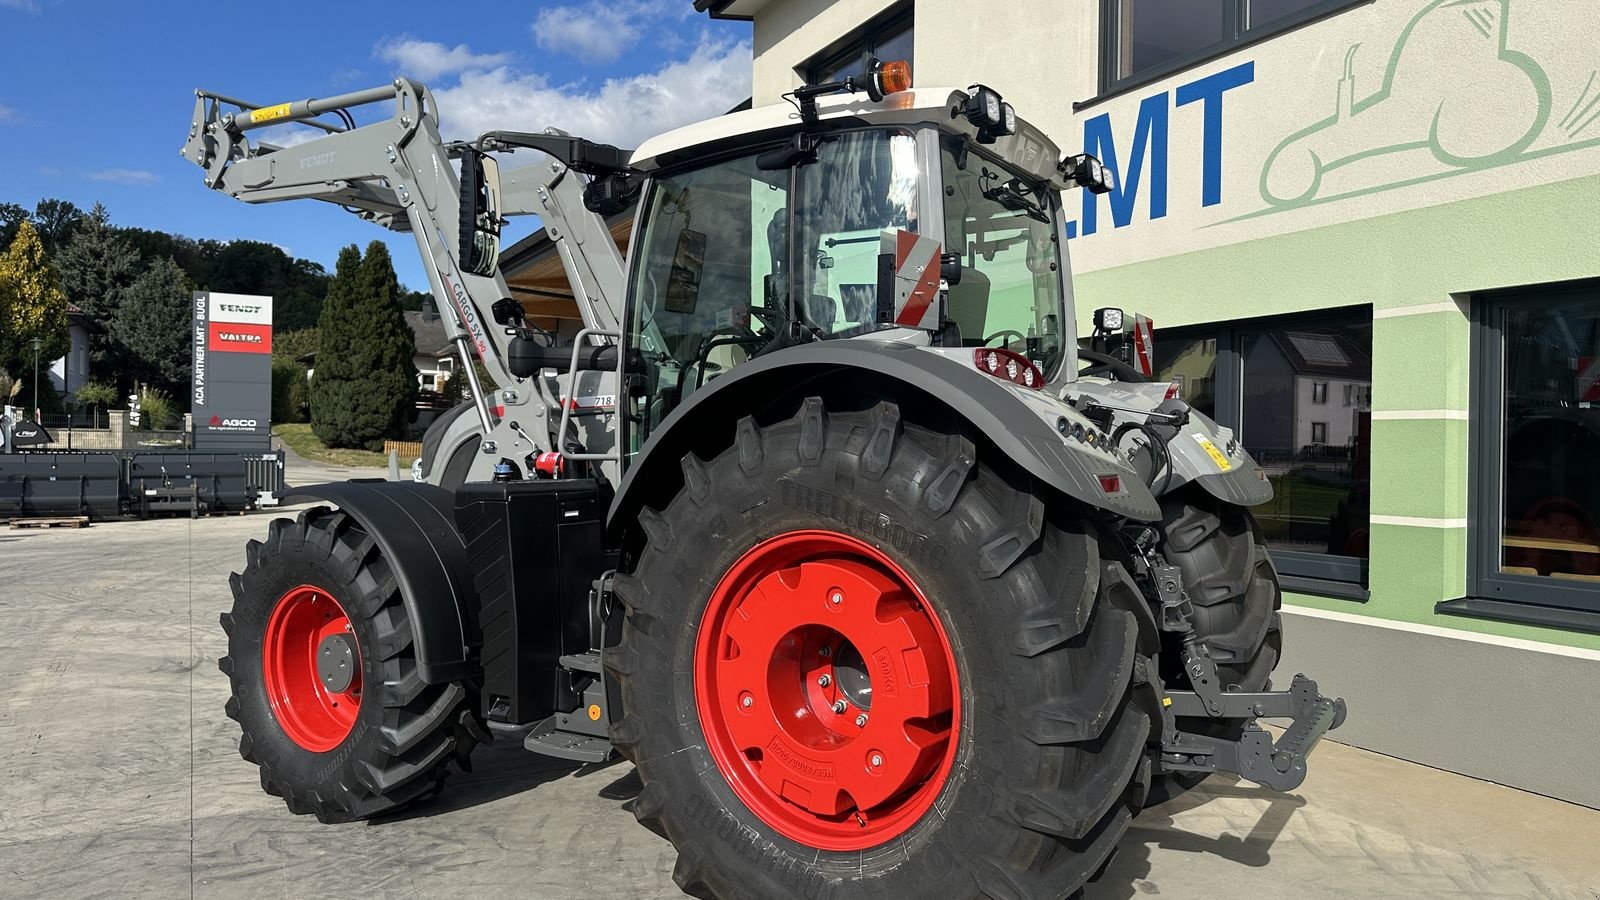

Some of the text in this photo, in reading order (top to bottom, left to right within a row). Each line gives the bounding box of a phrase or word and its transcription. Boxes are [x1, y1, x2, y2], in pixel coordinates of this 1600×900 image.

[1066, 60, 1254, 240] MT
[299, 151, 337, 169] FENDT
[197, 296, 206, 320] BUGL
[219, 304, 262, 314] FENDT
[453, 283, 475, 323] CARGO
[471, 323, 483, 340] 5X
[196, 326, 205, 345] LMT
[219, 331, 262, 343] VALTRA
[195, 346, 205, 386] PARTNER
[195, 386, 204, 405] ACA
[595, 396, 612, 405] 718
[780, 478, 948, 569] TRELLEBORG
